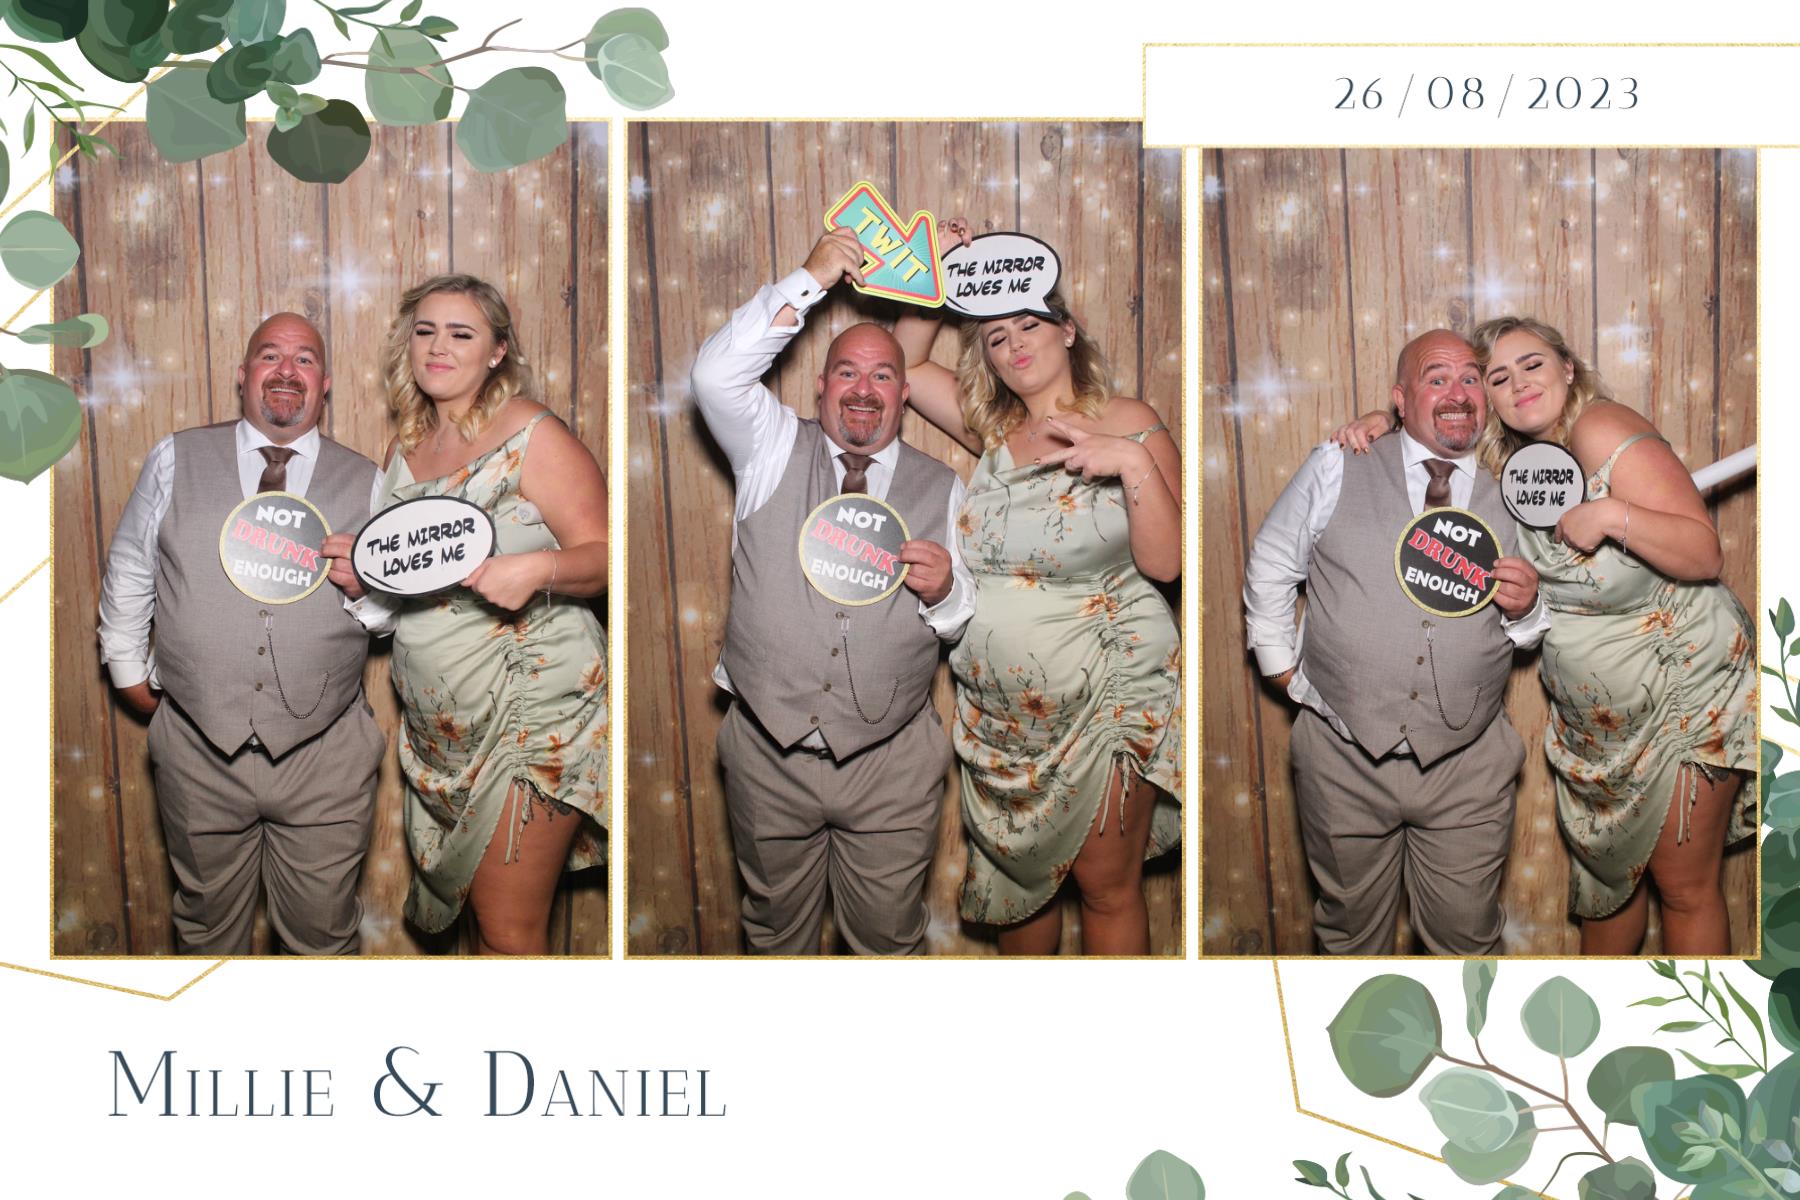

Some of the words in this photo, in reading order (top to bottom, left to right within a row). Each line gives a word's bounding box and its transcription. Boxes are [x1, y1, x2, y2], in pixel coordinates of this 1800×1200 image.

[855, 206, 930, 283] TWIT
[948, 261, 977, 278] THE
[982, 256, 1045, 275] MIRROR
[956, 280, 1003, 297] LOVES
[1008, 277, 1032, 294] ME
[1509, 469, 1529, 485] THE
[1532, 469, 1574, 485] MIRROR
[1516, 490, 1546, 506] LOVES
[1550, 491, 1566, 507] ME
[256, 505, 306, 528] NOT
[836, 506, 887, 532] NOT
[233, 518, 319, 572] DRUNK
[367, 534, 400, 556] THE
[408, 517, 475, 548] MIRROR
[813, 518, 897, 576] DRUNK
[1433, 518, 1482, 547] NOT
[232, 559, 312, 587] ENOUGH
[383, 550, 433, 577] LOVES
[441, 543, 465, 565] ME
[811, 558, 888, 591] ENOUGH
[1408, 528, 1491, 591] DRUNK
[1405, 566, 1480, 605] ENOUGH
